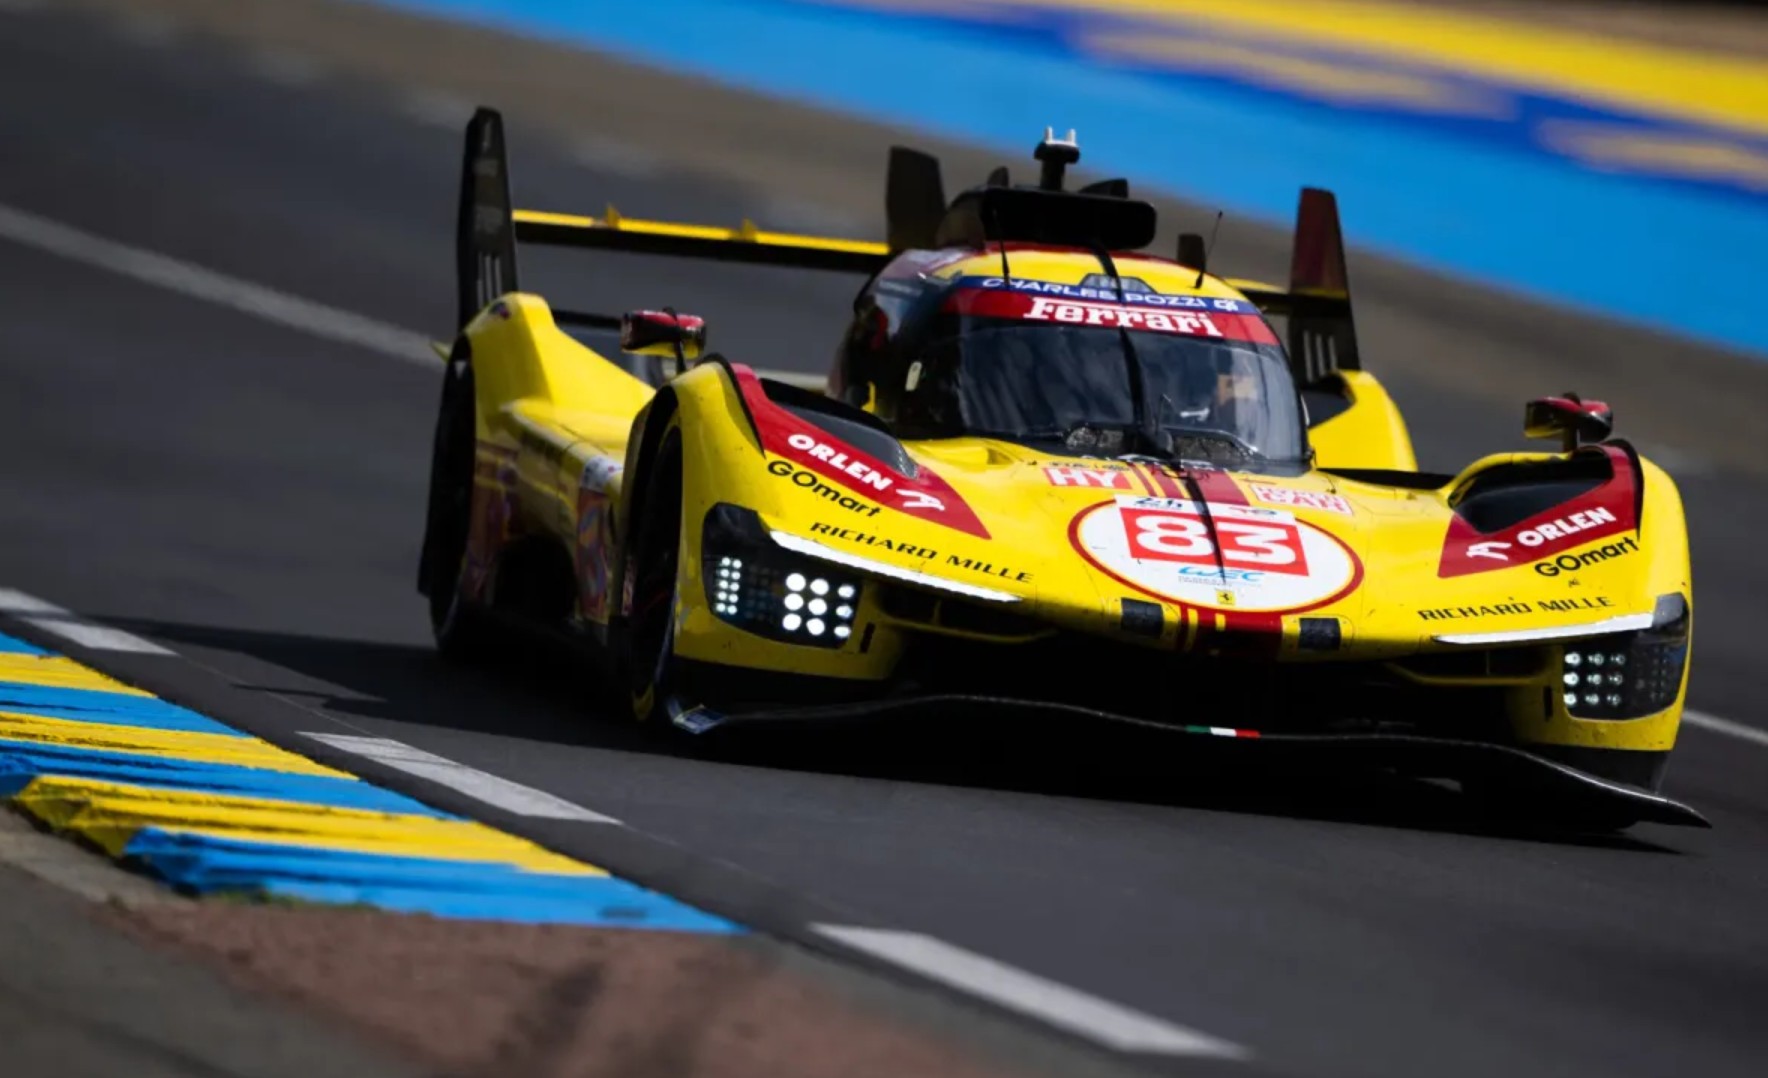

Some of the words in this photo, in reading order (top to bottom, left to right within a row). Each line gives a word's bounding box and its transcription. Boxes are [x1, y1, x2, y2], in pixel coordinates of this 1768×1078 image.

[982, 278, 1117, 301] CHARLES
[1125, 292, 1207, 307] POZZI
[1023, 297, 1223, 337] Ferrari
[788, 434, 893, 491] ORLEN
[1046, 468, 1118, 488] HY
[767, 460, 881, 518] GOmart
[1136, 515, 1297, 566] 83
[1517, 506, 1616, 547] ORLEN
[810, 522, 938, 560] RICHARD
[946, 554, 1035, 583] MILLE
[1534, 537, 1639, 578] GOmart
[1417, 602, 1533, 621] RICHARD
[1537, 596, 1616, 613] MILLE
